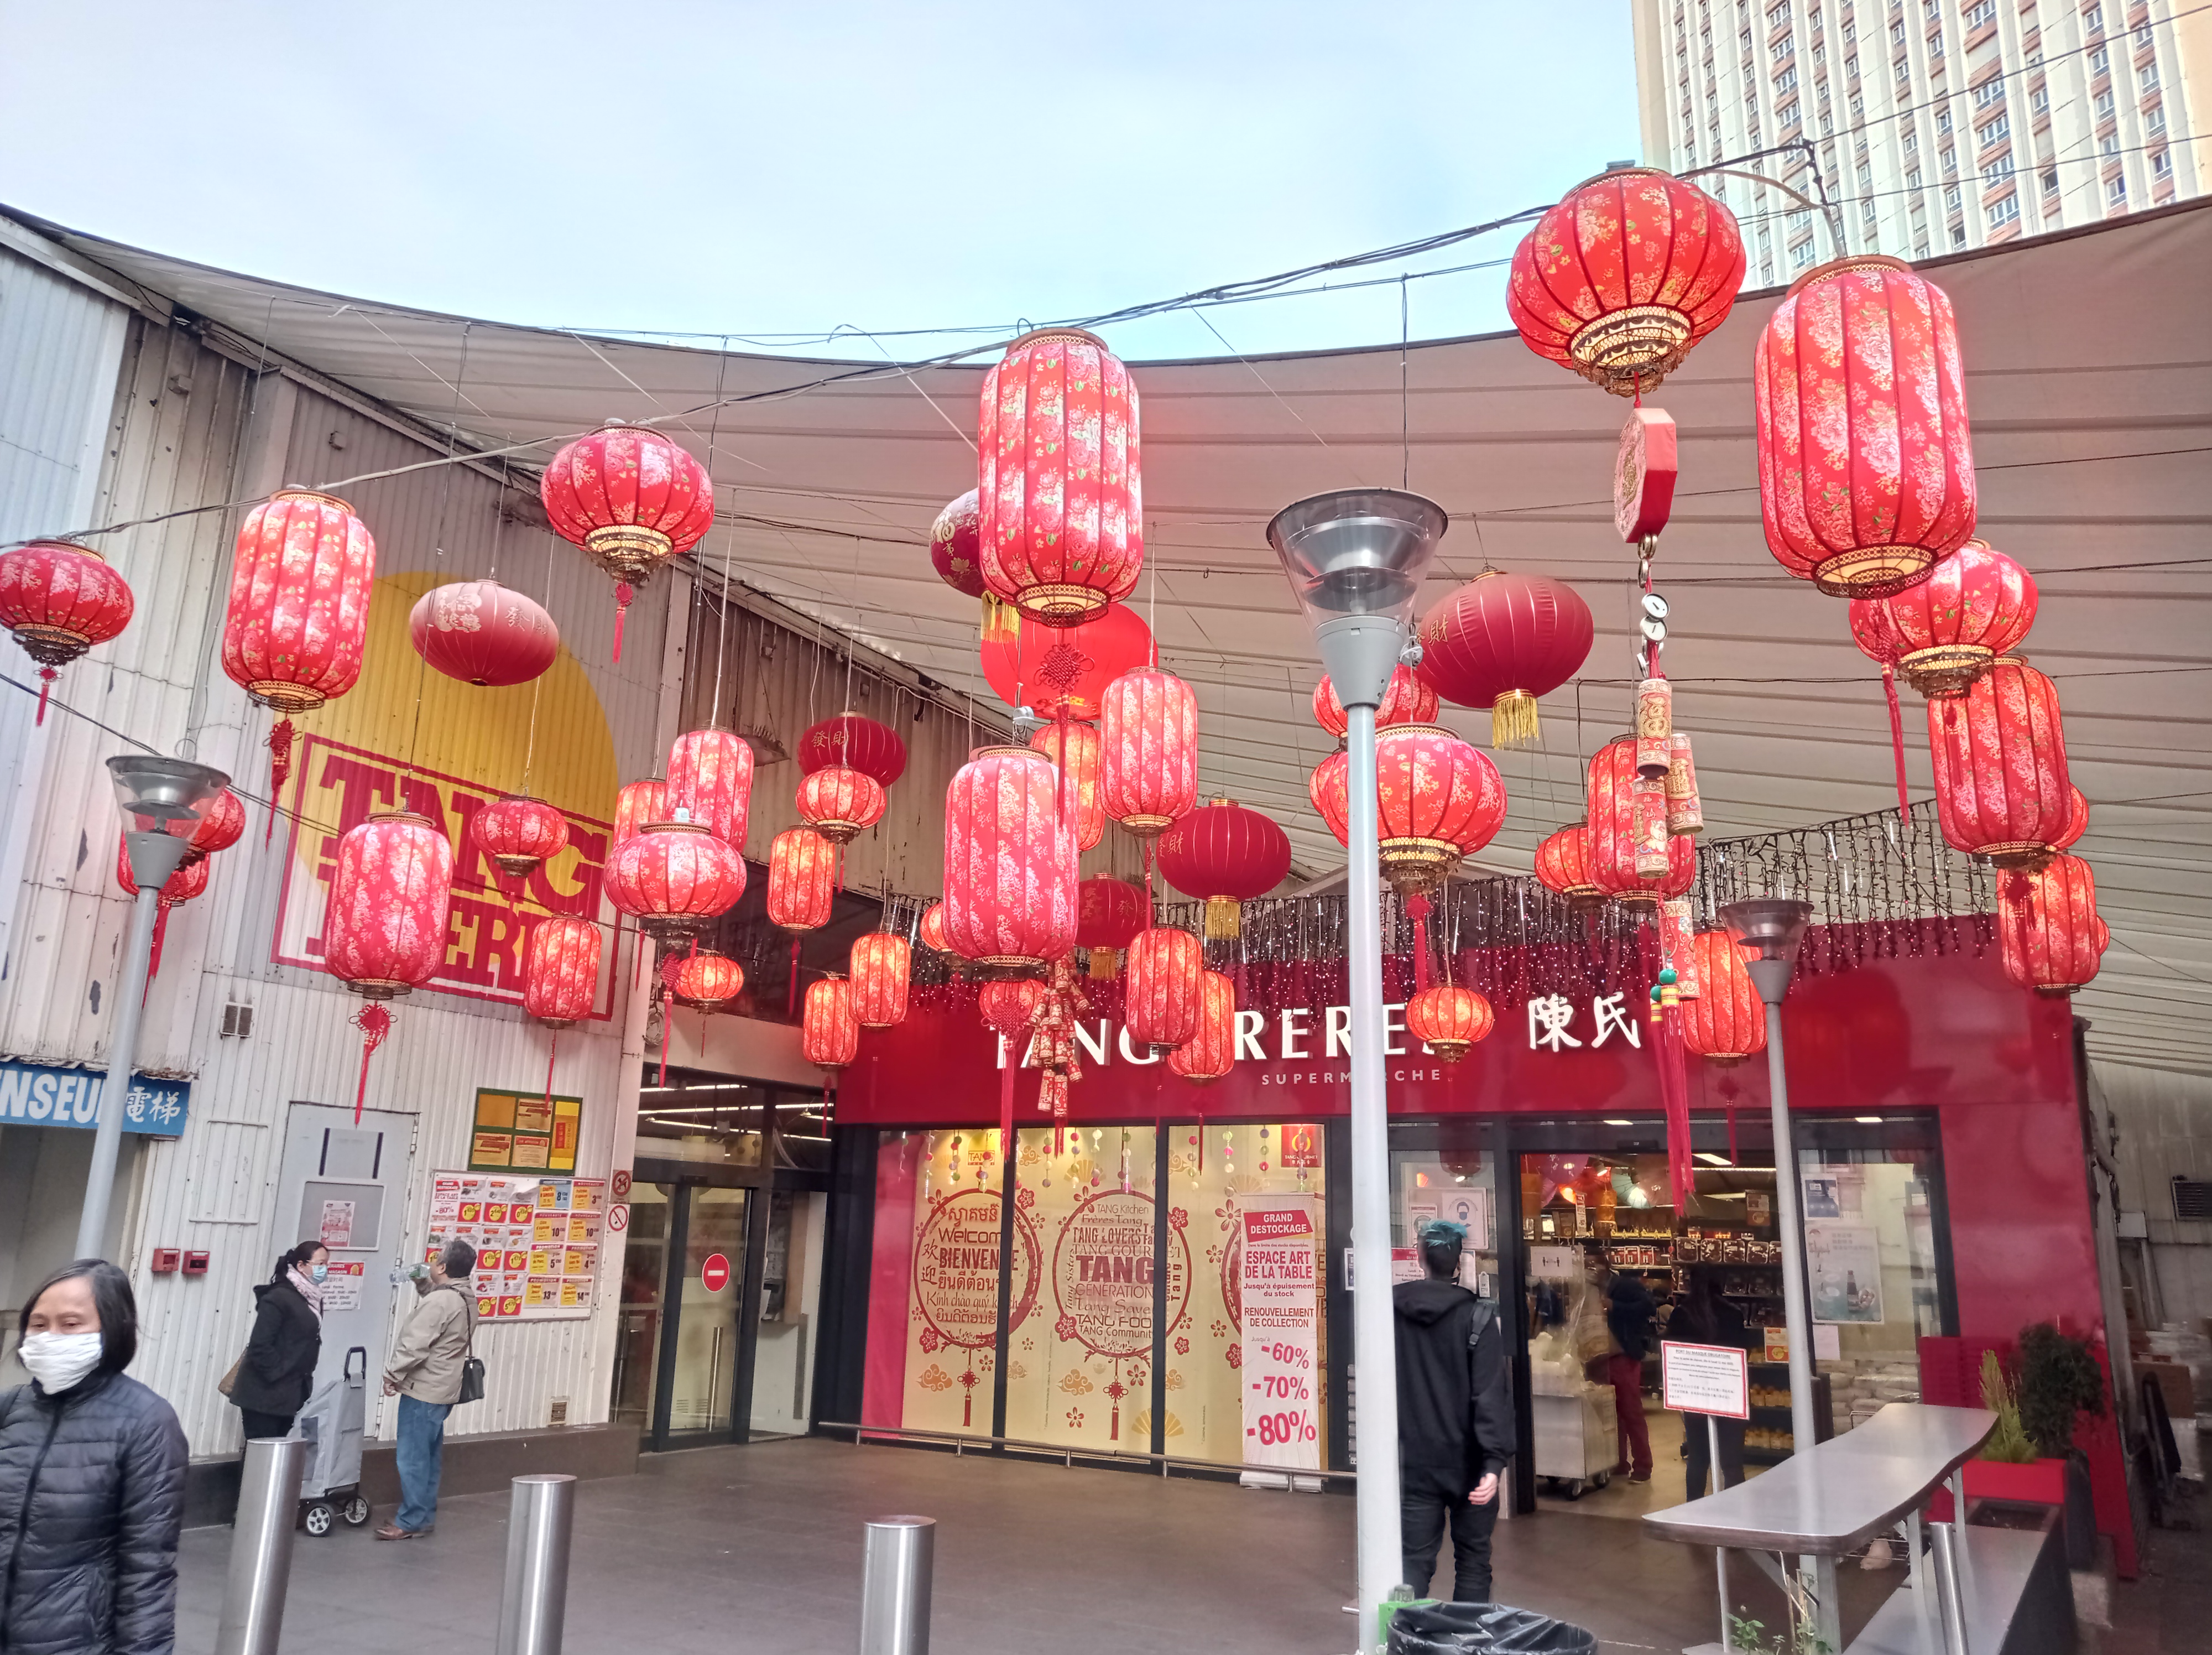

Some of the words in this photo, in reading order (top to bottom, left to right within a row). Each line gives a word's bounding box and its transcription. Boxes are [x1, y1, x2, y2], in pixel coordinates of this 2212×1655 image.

[811, 730, 849, 748] 發財
[1528, 992, 1641, 1053] 陳氏
[1262, 1069, 1441, 1085] SUPERMCHE
[0, 1068, 107, 1124] NSEU
[126, 1086, 181, 1125] 電梯
[1097, 1204, 1118, 1213] TANG
[1120, 1205, 1149, 1214] Kitchen
[1082, 1214, 1114, 1224] Frères
[1114, 1215, 1143, 1227] Tang
[1263, 1213, 1293, 1222] GRAND
[938, 1227, 1014, 1243] Welcom
[1073, 1227, 1099, 1243] TANG
[1250, 1224, 1307, 1234] DESTOCKAGE
[1073, 1244, 1108, 1256] TANG
[1112, 1246, 1181, 1258] GOURET
[1246, 1251, 1286, 1264] ESPACE
[1289, 1251, 1311, 1264] ART
[940, 1248, 1019, 1271] BIENVENE
[1066, 1248, 1076, 1283] Sisters
[1076, 1255, 1155, 1284] TANG
[1245, 1266, 1259, 1279] DE
[1261, 1266, 1276, 1279] LA
[1278, 1266, 1312, 1279] TABLE
[1171, 1263, 1182, 1301] Tang
[951, 1292, 970, 1308] chào
[1065, 1285, 1076, 1310] Tang
[1074, 1297, 1109, 1316] Tang
[1244, 1307, 1314, 1317] RENOUVELLEMENT
[1076, 1314, 1115, 1326] TANG
[1250, 1318, 1260, 1327] DE
[1261, 1318, 1309, 1328] COLLECTION
[1079, 1325, 1103, 1336] TANG
[1261, 1342, 1310, 1369] -60%
[1253, 1376, 1309, 1399] -70%
[1247, 1409, 1316, 1445] -80%
